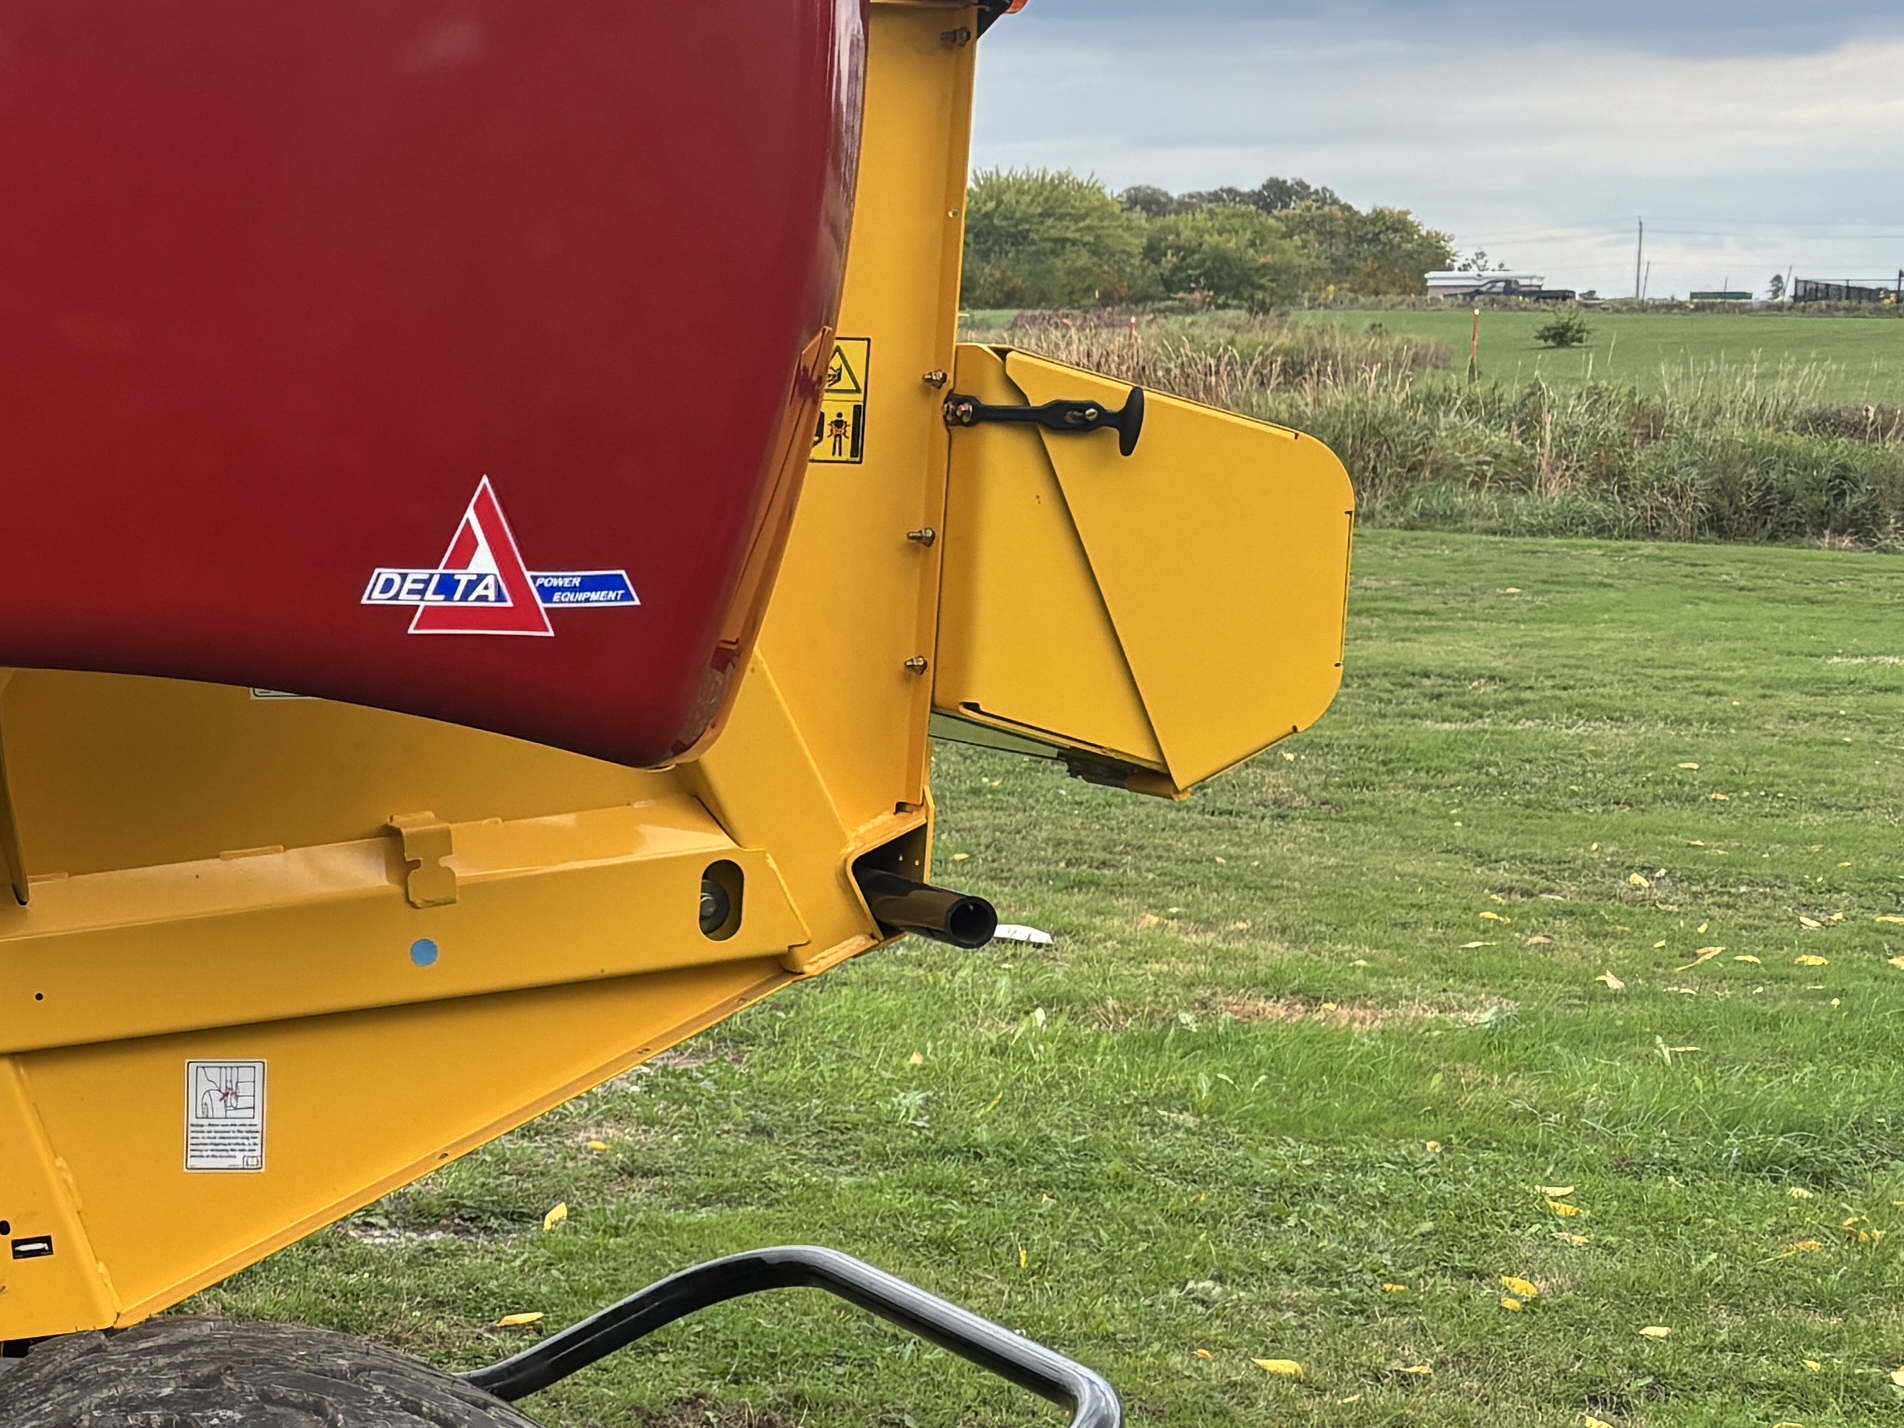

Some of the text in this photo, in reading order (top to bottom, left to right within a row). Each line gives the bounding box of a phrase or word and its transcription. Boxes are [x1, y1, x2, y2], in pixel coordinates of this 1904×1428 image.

[370, 573, 498, 602] DELTA
[535, 577, 581, 588] POWER
[552, 590, 624, 602] EQUIPMENT
